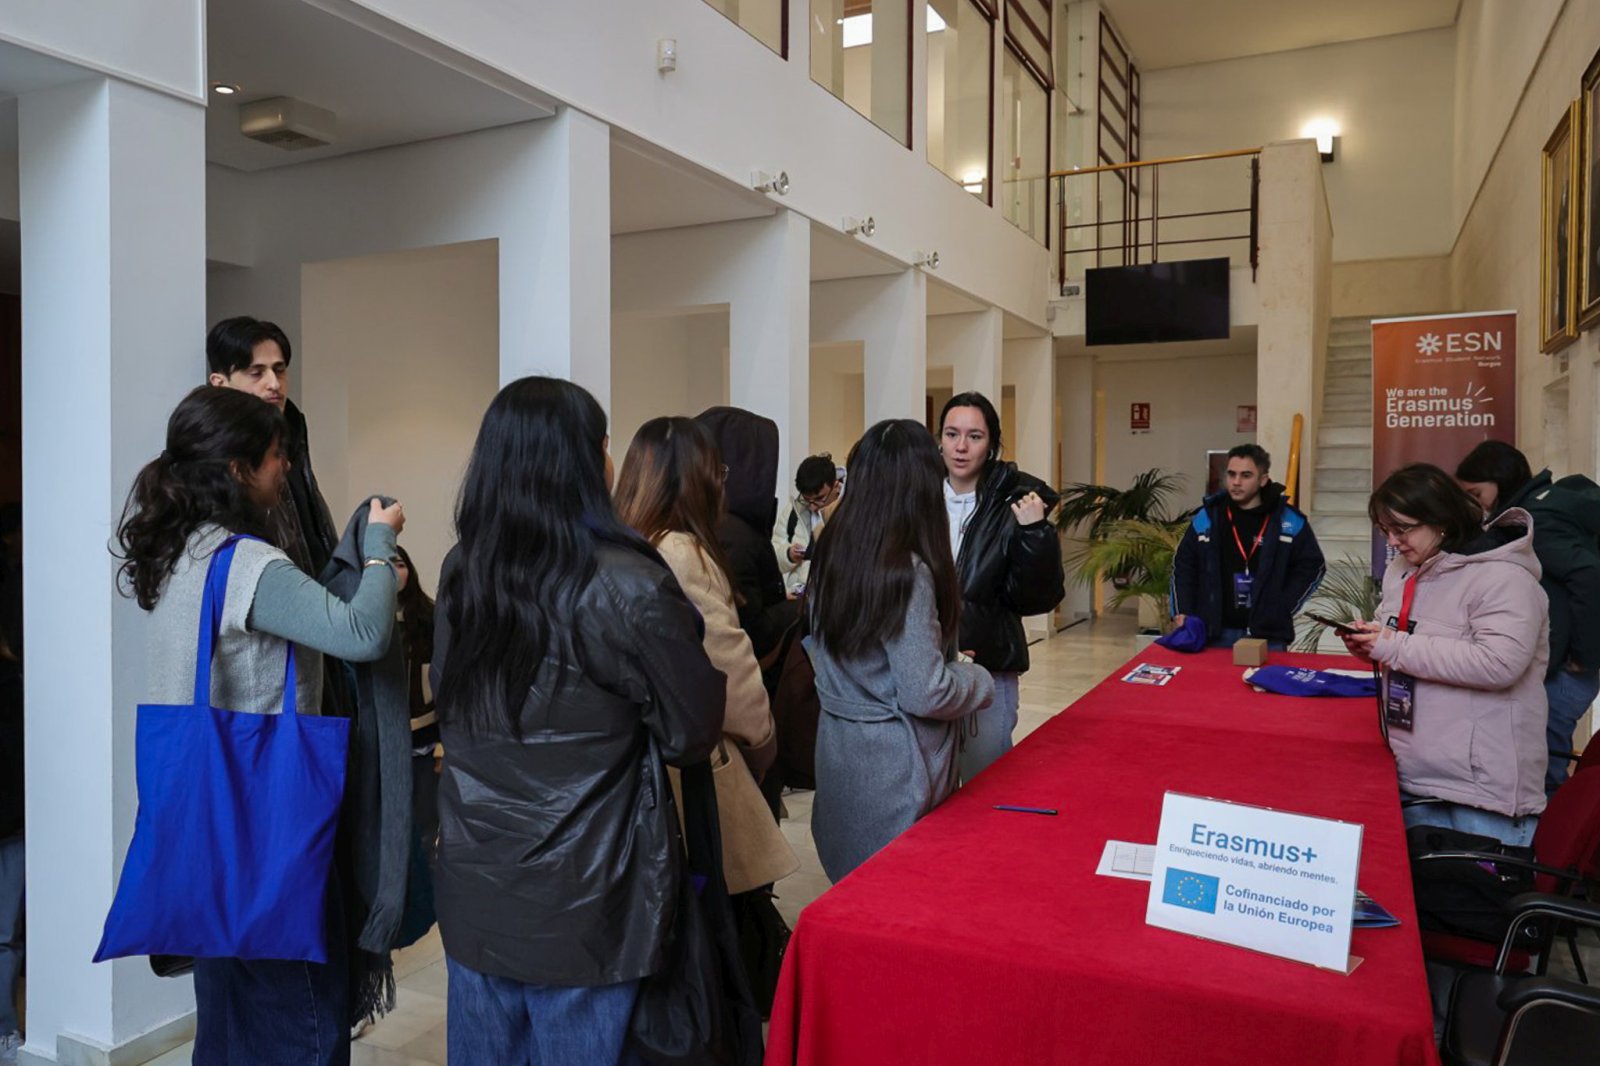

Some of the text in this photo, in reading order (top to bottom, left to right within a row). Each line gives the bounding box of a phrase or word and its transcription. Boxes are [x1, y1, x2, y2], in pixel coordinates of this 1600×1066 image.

[1446, 331, 1502, 353] ESN
[1385, 387, 1448, 398] We are the
[1386, 397, 1474, 413] Erasmus
[1386, 411, 1495, 428] Generation
[1190, 823, 1318, 864] Erasmus+
[1169, 843, 1339, 885] Enriqueciendo vidas, abriendo mentes.
[1225, 884, 1336, 917] Cofinanciado por
[1223, 899, 1334, 934] la Unión Europea
